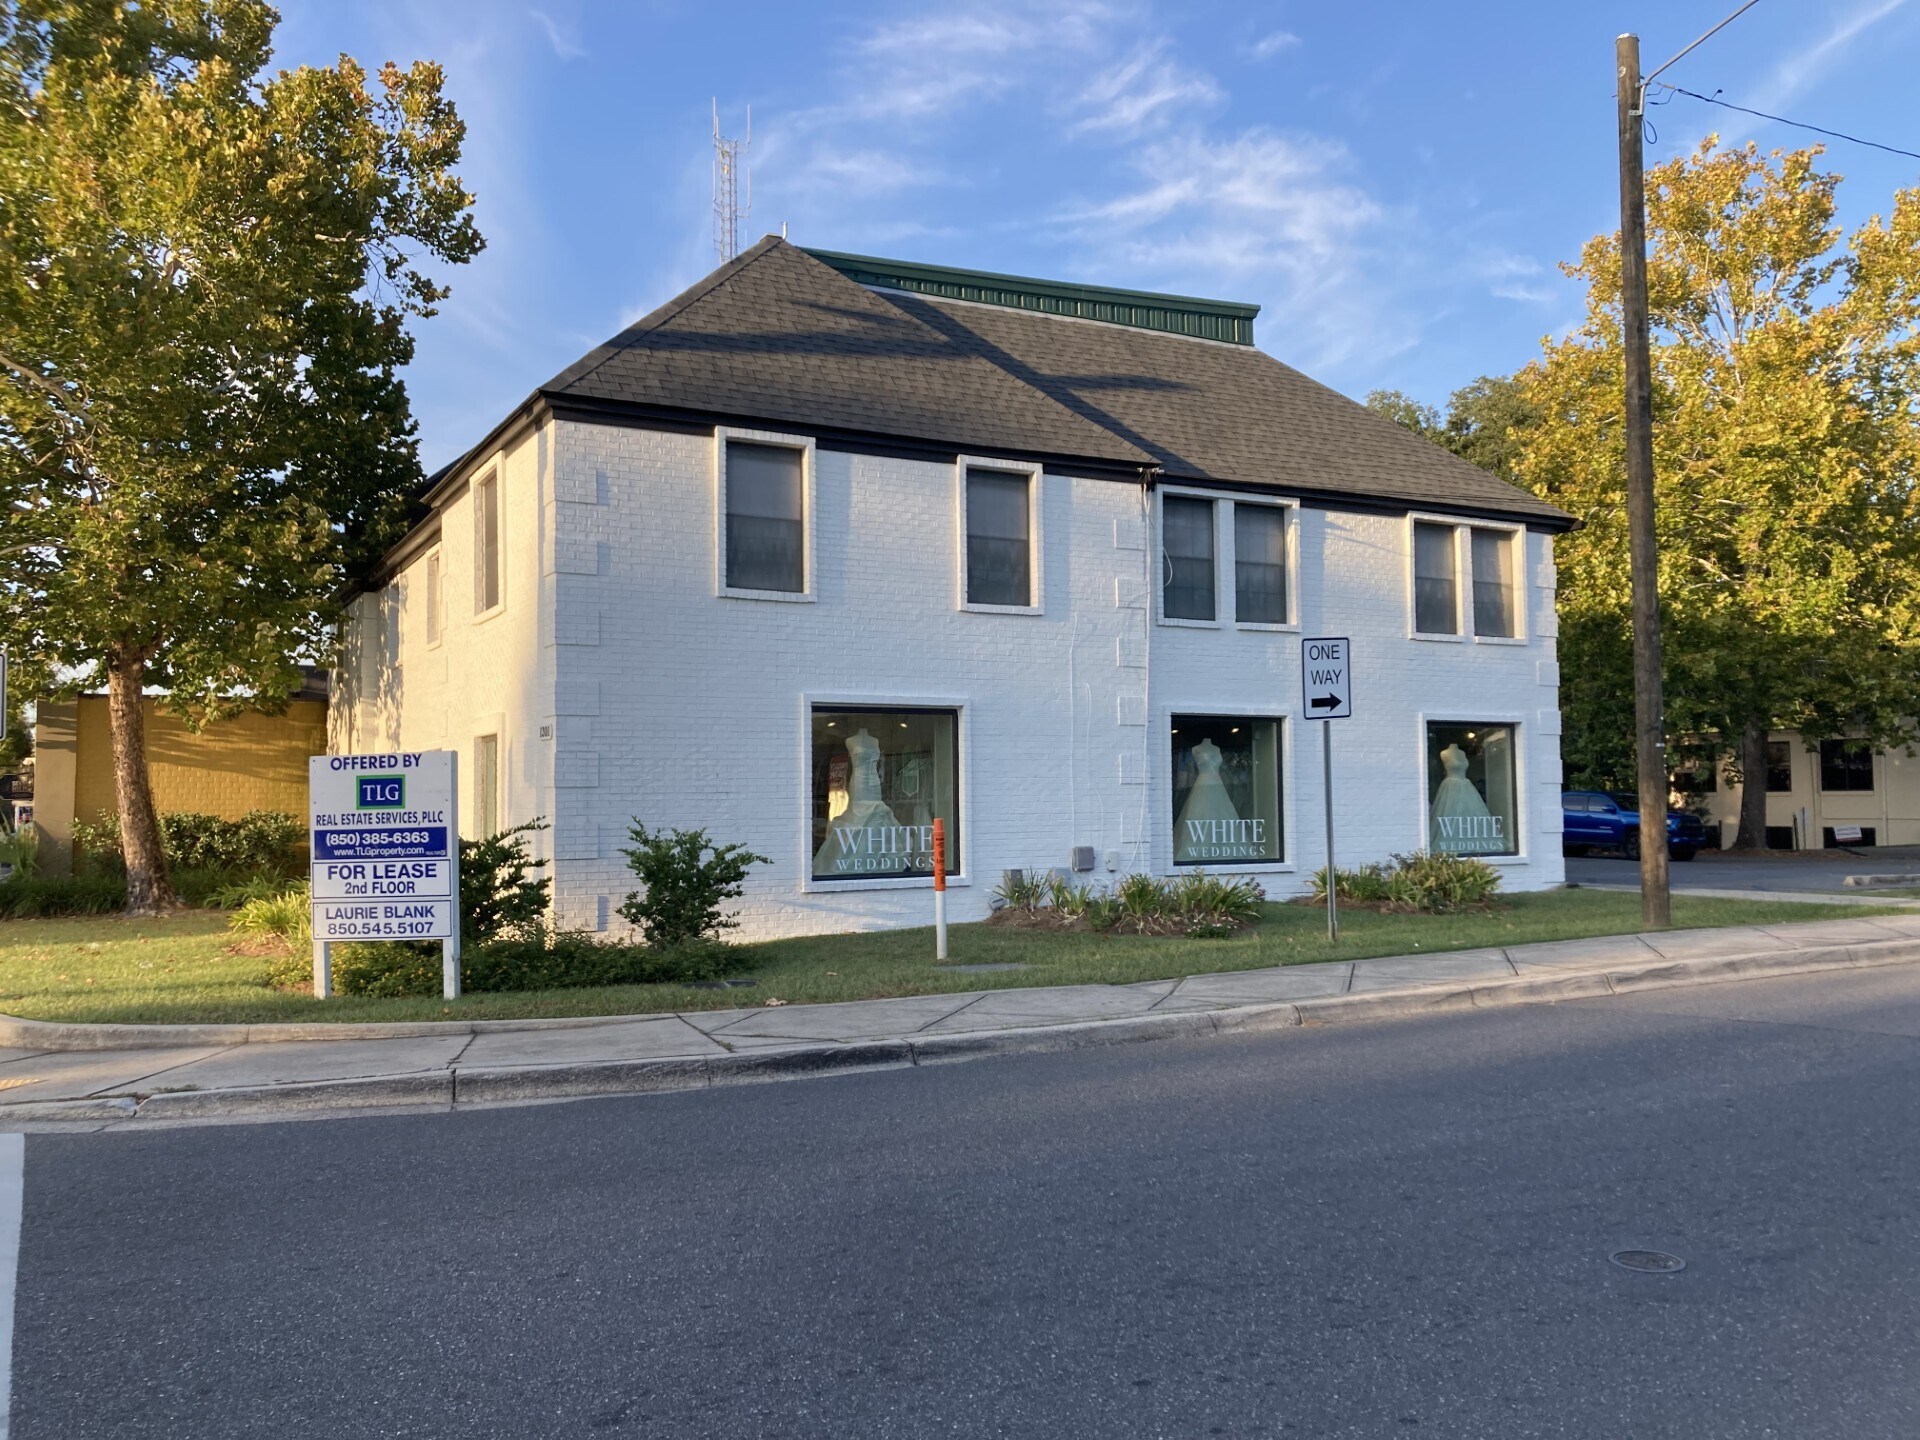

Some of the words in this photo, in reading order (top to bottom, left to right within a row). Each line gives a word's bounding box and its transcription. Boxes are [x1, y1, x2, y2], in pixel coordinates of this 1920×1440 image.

[1309, 644, 1340, 660] ONE
[1310, 669, 1342, 685] WAY
[330, 755, 398, 771] OFFERED
[403, 753, 422, 768] BY
[362, 784, 400, 801] TLG
[316, 814, 338, 826] REAL
[341, 812, 373, 825] ESTATE
[376, 811, 421, 826] SERVICES,
[422, 810, 443, 823] PLLC
[1185, 819, 1266, 844] WHITE
[1436, 816, 1504, 839] WHITE
[326, 832, 360, 847] (850)
[362, 831, 430, 845] 385-6363
[833, 825, 935, 855] WHITE
[1439, 840, 1504, 851] WEDDINGS
[333, 846, 425, 857] www.TLGproperty.com
[1188, 845, 1266, 858] WEDDINGS
[327, 864, 366, 880] FOR
[373, 863, 437, 879] LEASE
[836, 856, 935, 871] WEDDINGS
[344, 881, 367, 895] 2nd
[372, 881, 415, 894] FLOOR
[325, 906, 378, 920] LAURIE
[384, 905, 435, 919] BLANK
[328, 921, 434, 935] 850.545.5107
